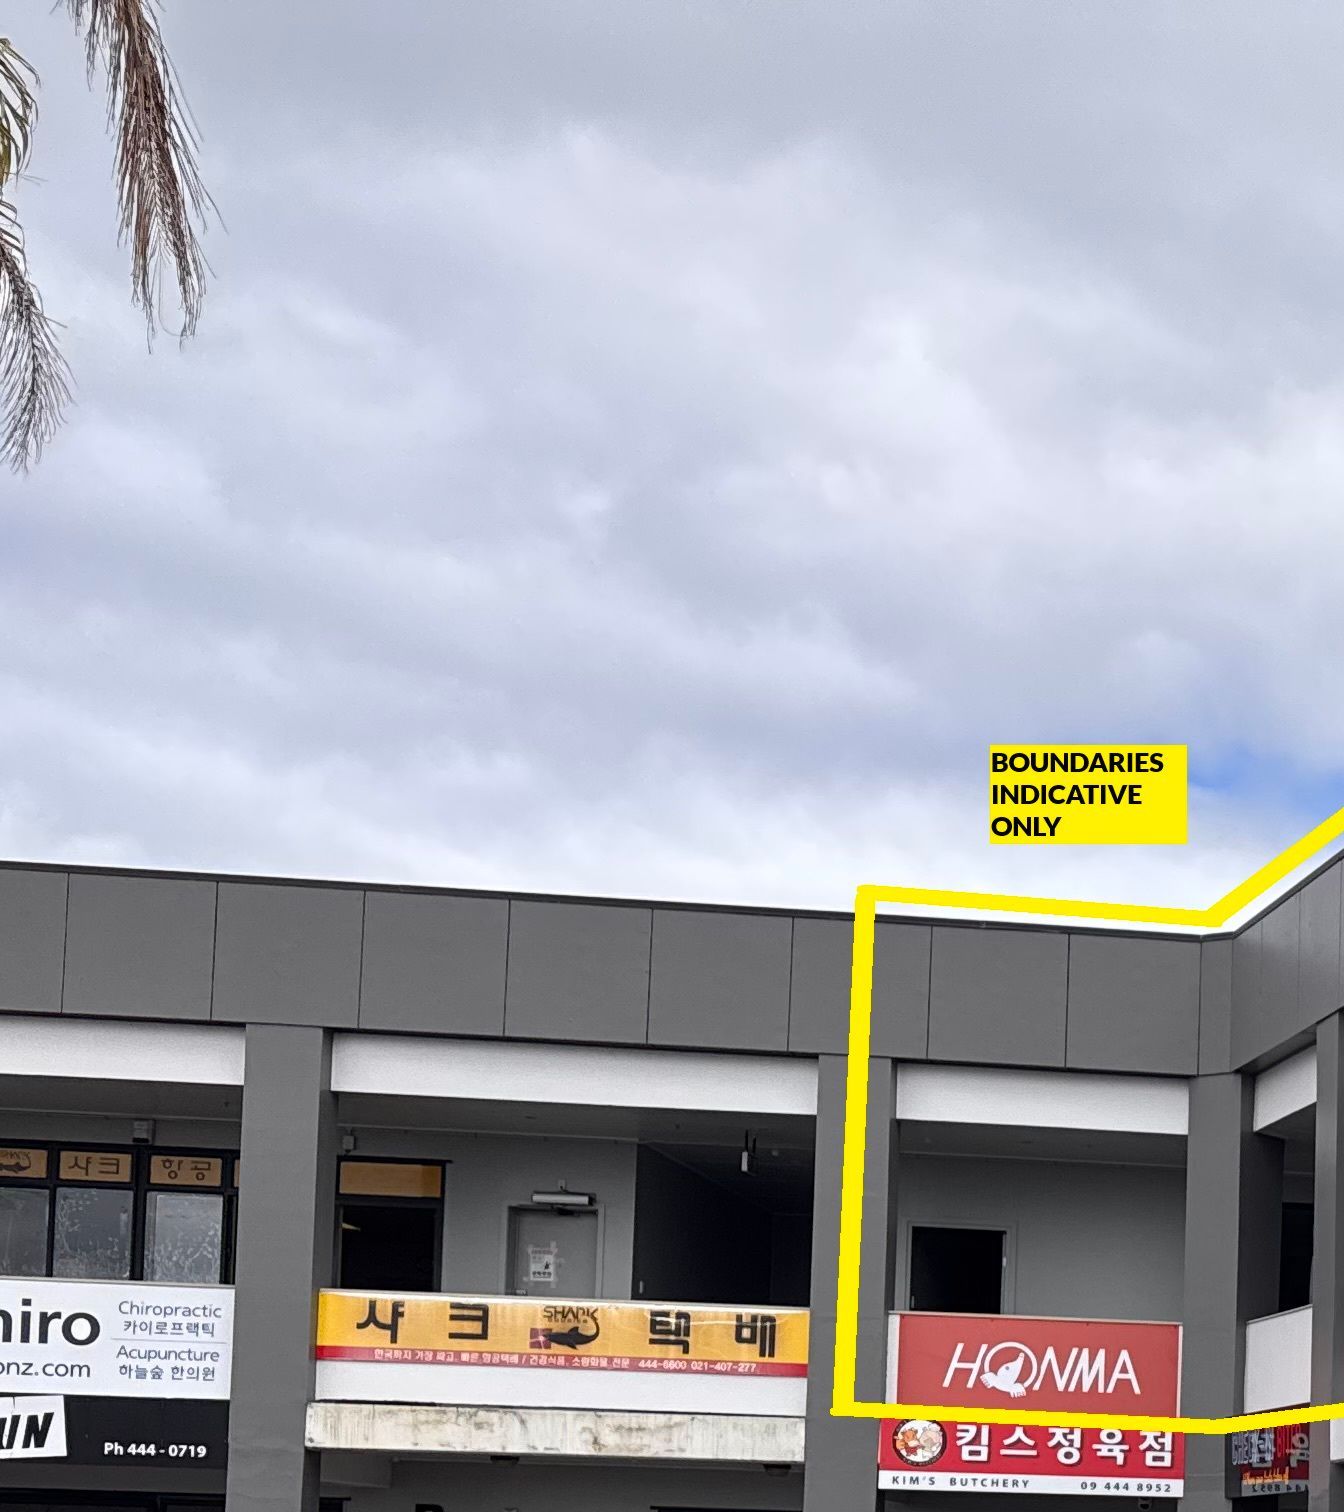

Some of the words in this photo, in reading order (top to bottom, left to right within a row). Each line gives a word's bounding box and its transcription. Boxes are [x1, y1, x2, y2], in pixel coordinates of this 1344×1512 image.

[67, 1155, 120, 1177] 샤크
[160, 1157, 212, 1182] 항공
[118, 1300, 222, 1319] Chiropractic
[543, 1305, 599, 1321] SHARK
[123, 1320, 215, 1337] 카이로프랙틱
[356, 1300, 489, 1344] 샤크
[648, 1310, 777, 1358] 택배
[115, 1344, 220, 1362] Acupuncture
[171, 1365, 215, 1382] 한의원
[942, 1341, 1141, 1398] HONMA
[103, 1442, 124, 1456] Ph
[127, 1443, 157, 1457] 444
[168, 1445, 207, 1459] 0719
[954, 1424, 1173, 1469] 킴스정육점
[891, 1475, 936, 1487] KIM'S
[949, 1476, 1030, 1490] BUTCHERY
[1080, 1481, 1097, 1491] 09
[1103, 1482, 1130, 1492] 444
[1136, 1482, 1171, 1493] 8952
